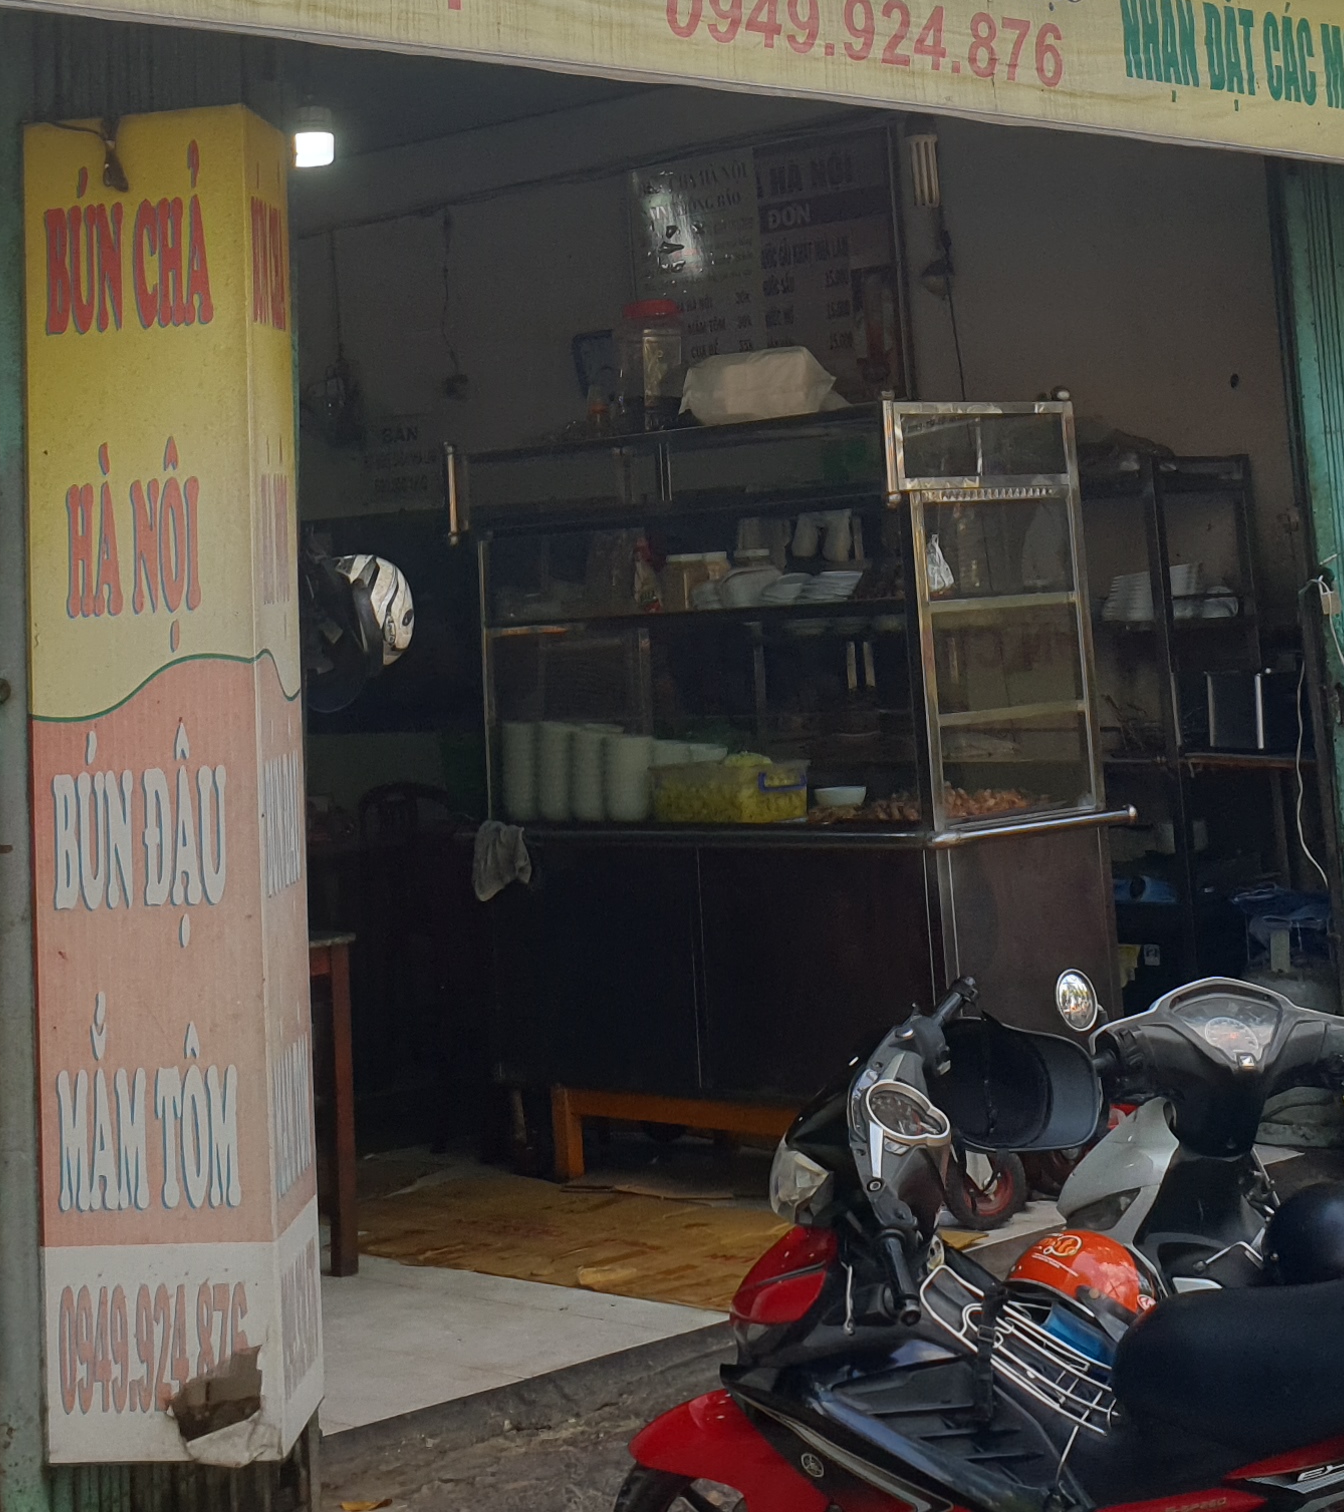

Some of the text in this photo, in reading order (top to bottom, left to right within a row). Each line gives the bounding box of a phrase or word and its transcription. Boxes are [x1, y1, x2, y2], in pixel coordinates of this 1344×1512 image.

[1263, 2, 1317, 106] CÁC
[44, 167, 124, 336] BÚN
[133, 139, 215, 329] CHẢ
[66, 442, 124, 620] HÀ
[130, 436, 201, 653] NỘI
[53, 730, 134, 911] BÚN
[142, 720, 227, 948] ĐẬU
[57, 991, 149, 1211] MẮM
[154, 1020, 241, 1209] TÔM
